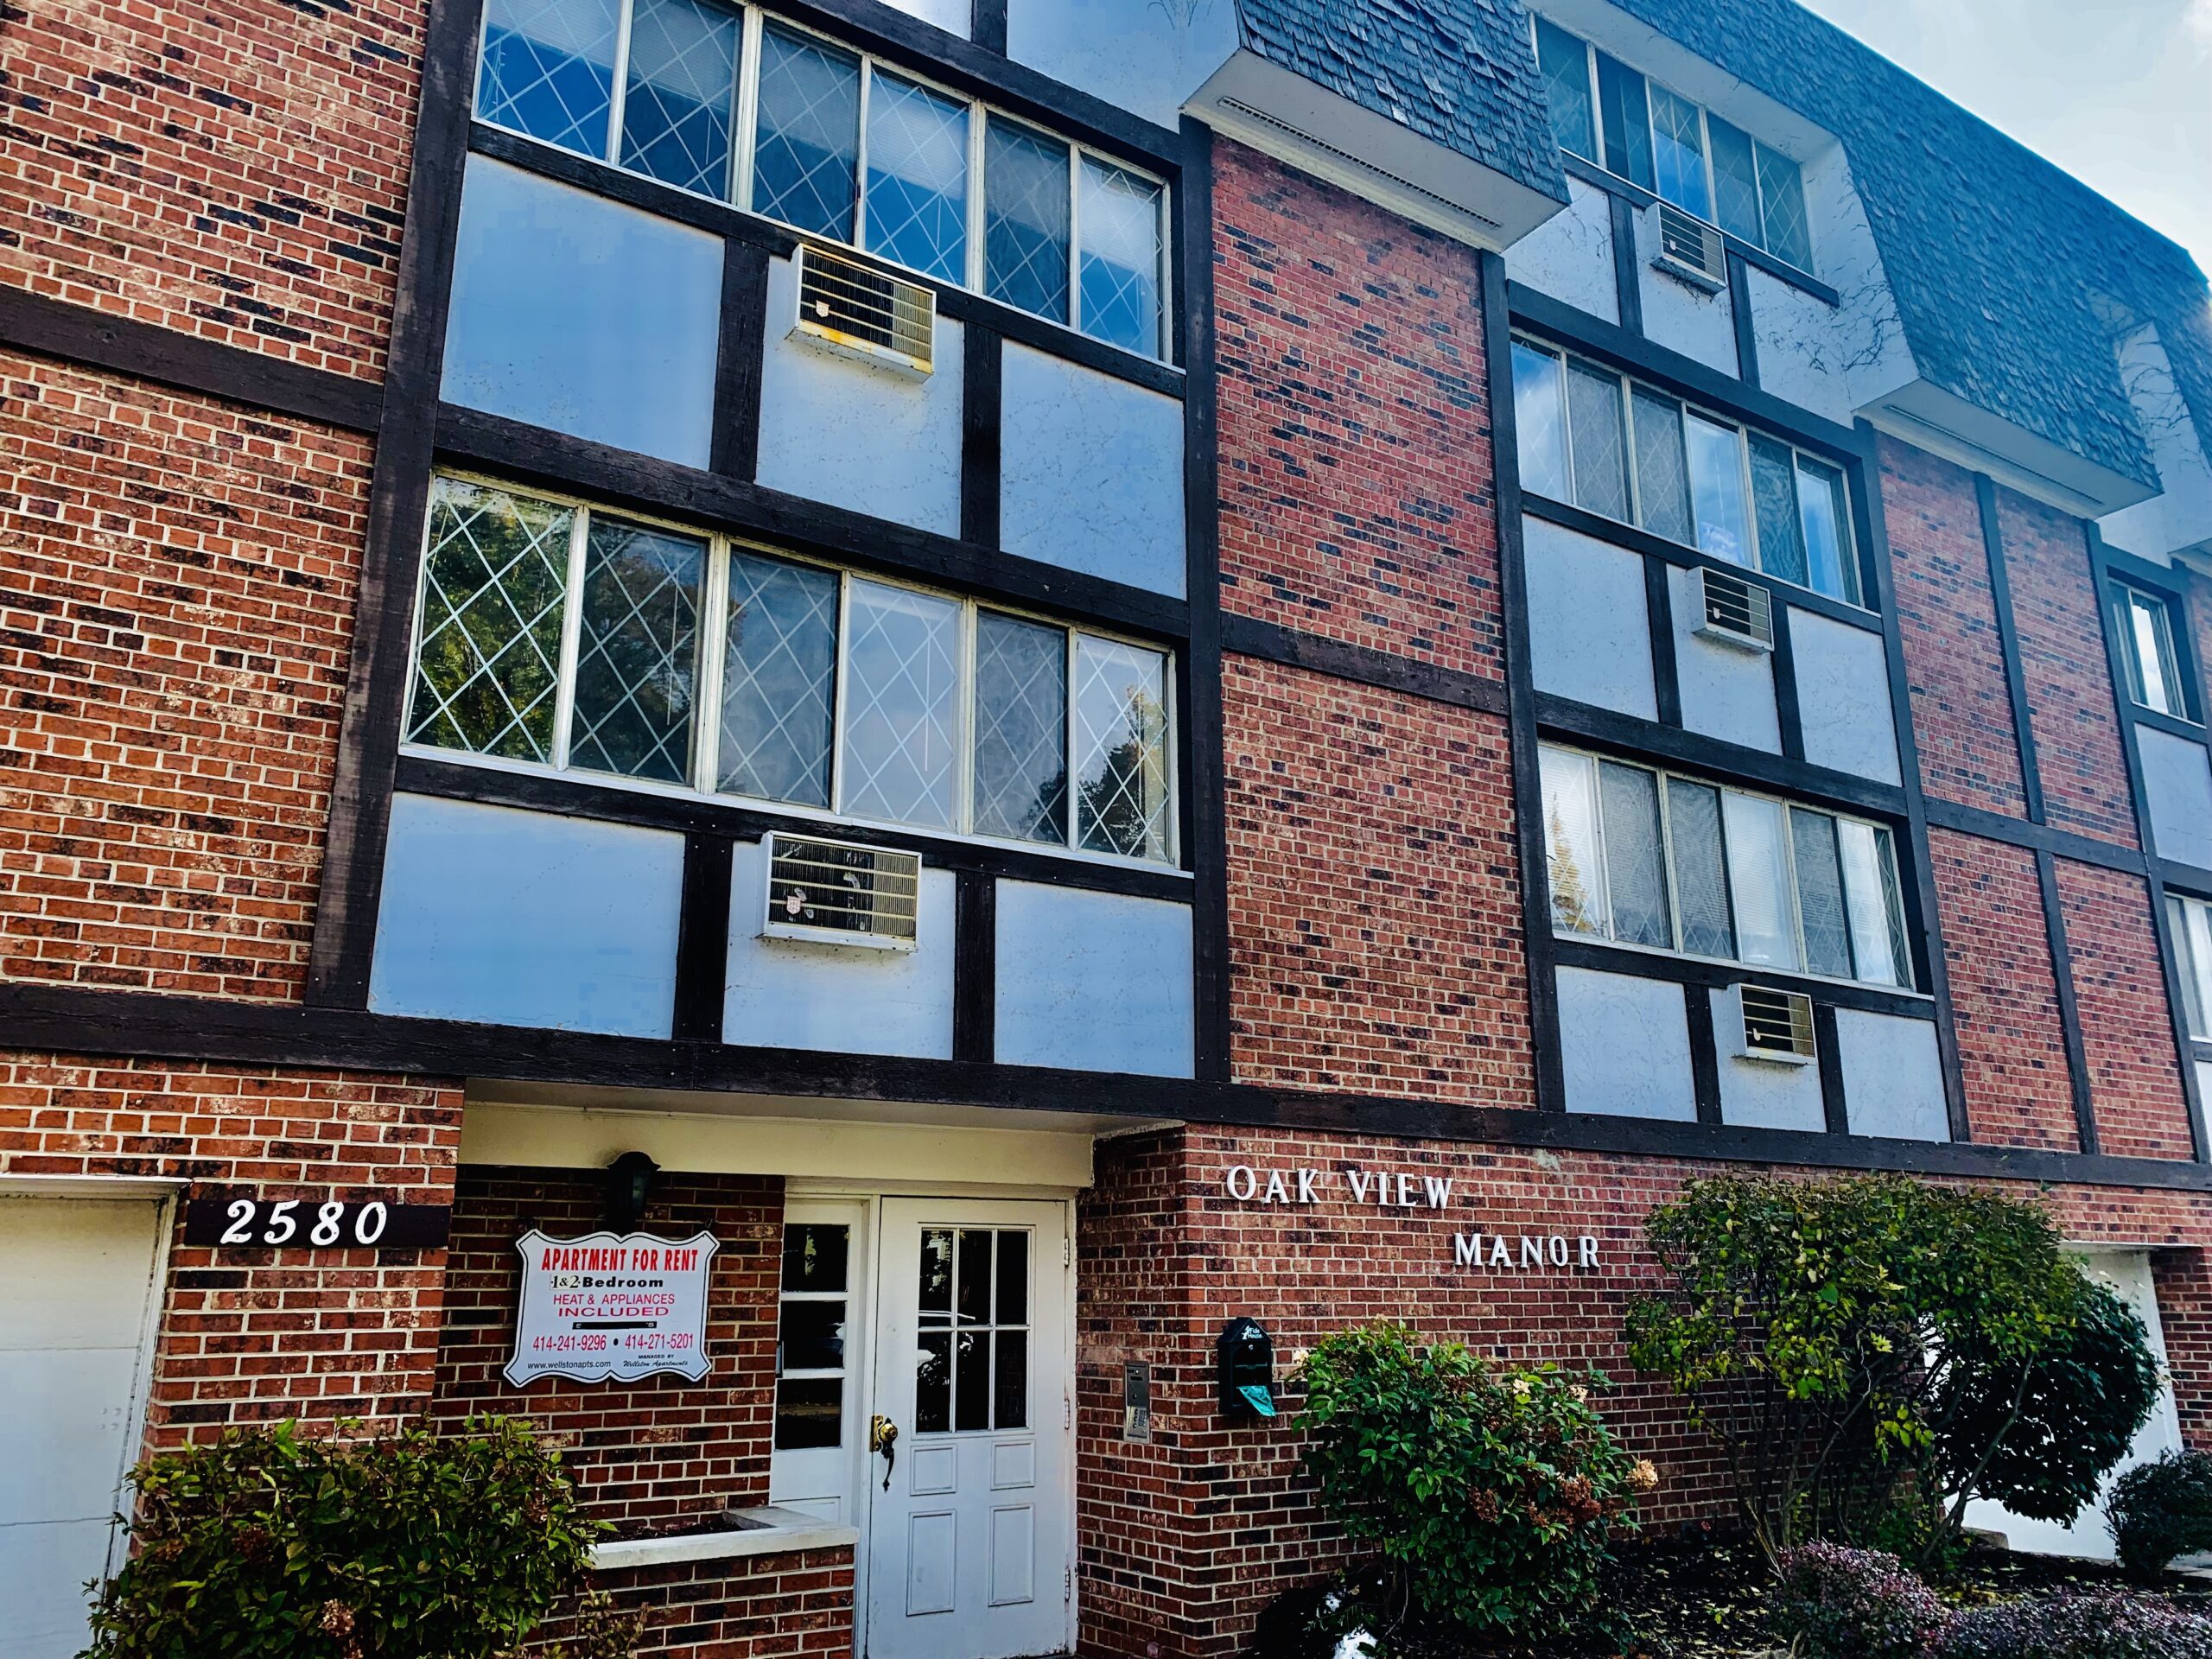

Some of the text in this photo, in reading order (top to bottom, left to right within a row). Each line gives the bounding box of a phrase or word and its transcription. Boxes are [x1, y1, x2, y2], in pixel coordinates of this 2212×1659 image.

[1226, 1165, 1454, 1210] OAK VIEW
[219, 1198, 388, 1246] 2580
[541, 1248, 698, 1271] APARTMENT FOR RENT
[1453, 1232, 1600, 1268] MANOR
[582, 1275, 664, 1287] Bedroom
[553, 1294, 676, 1305] HEAT & APPLIANCES
[558, 1306, 670, 1317] INCLUDED
[532, 1332, 694, 1351] 414-241-9296 414-271-5201
[527, 1360, 612, 1370] www.wellstonapts.com
